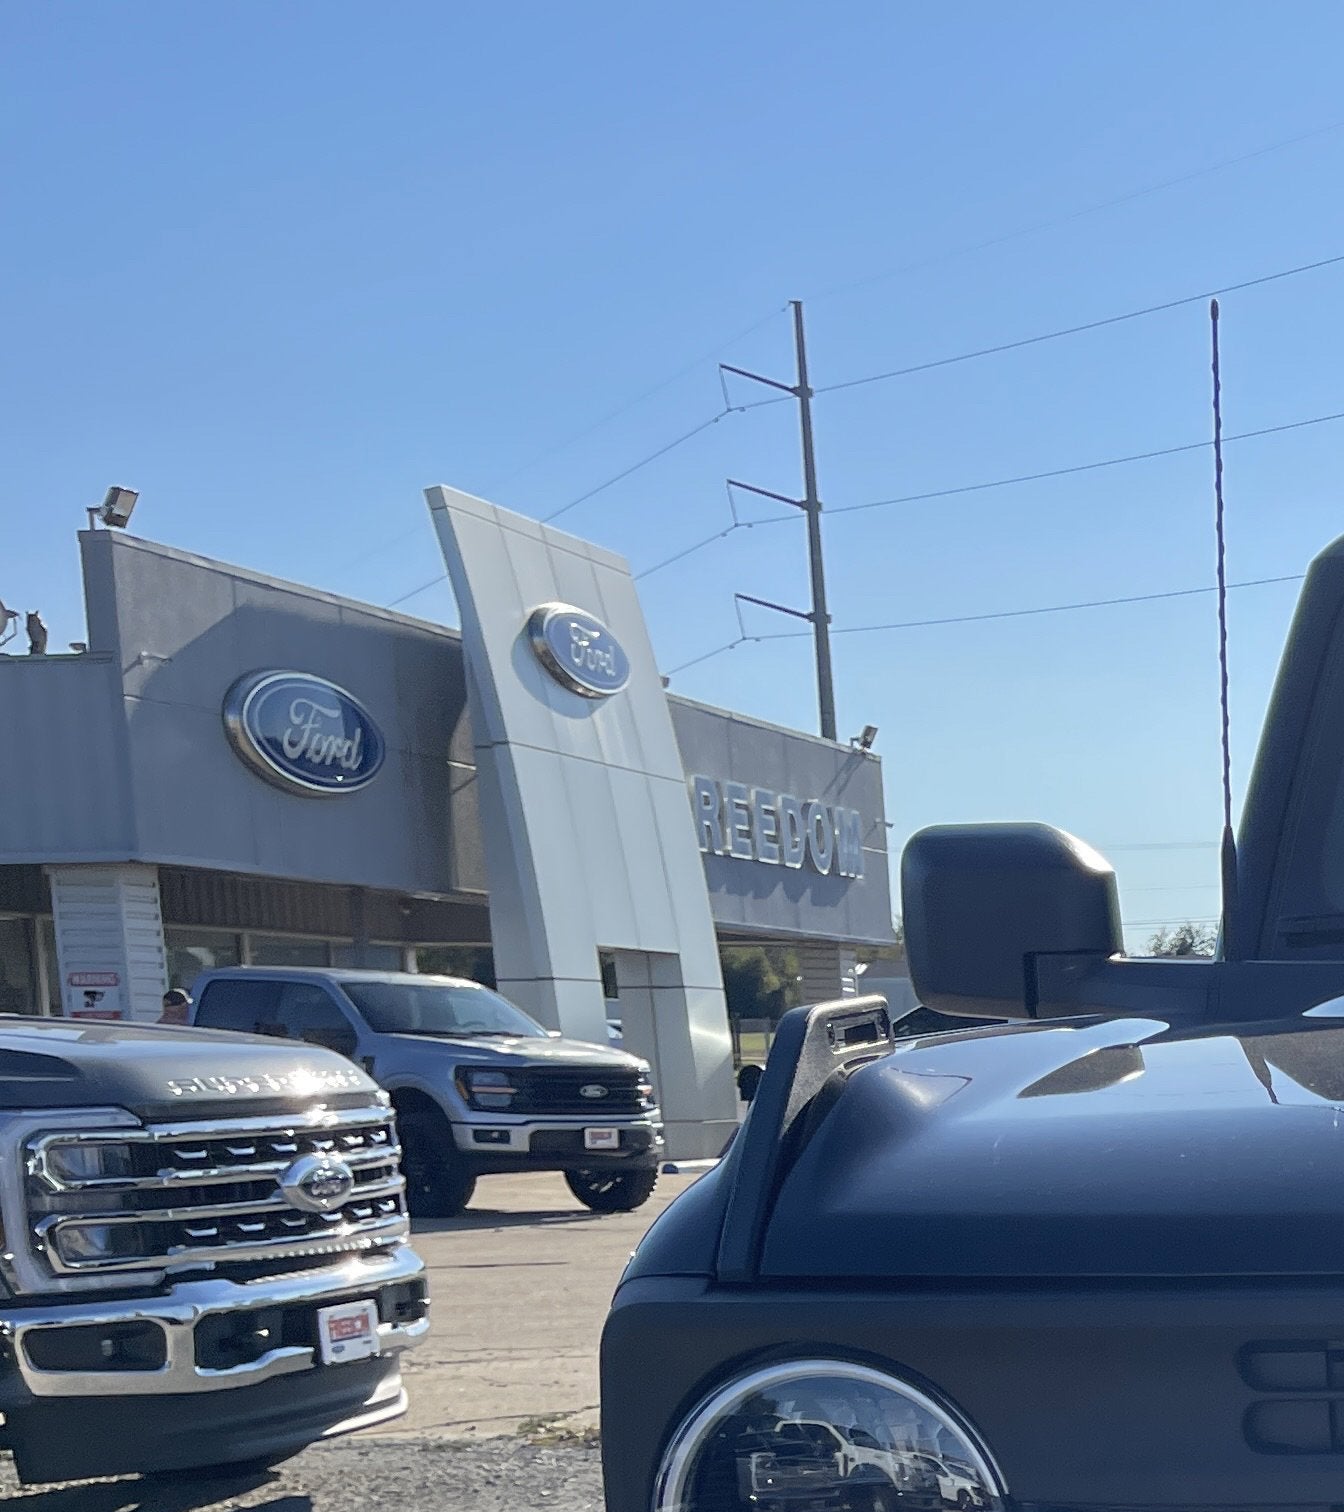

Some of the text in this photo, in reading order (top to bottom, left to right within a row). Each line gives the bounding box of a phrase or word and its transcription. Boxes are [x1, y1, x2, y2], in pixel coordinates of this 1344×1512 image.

[569, 621, 617, 677] Ford
[282, 698, 363, 771] Ford
[690, 773, 865, 880] REEDOM
